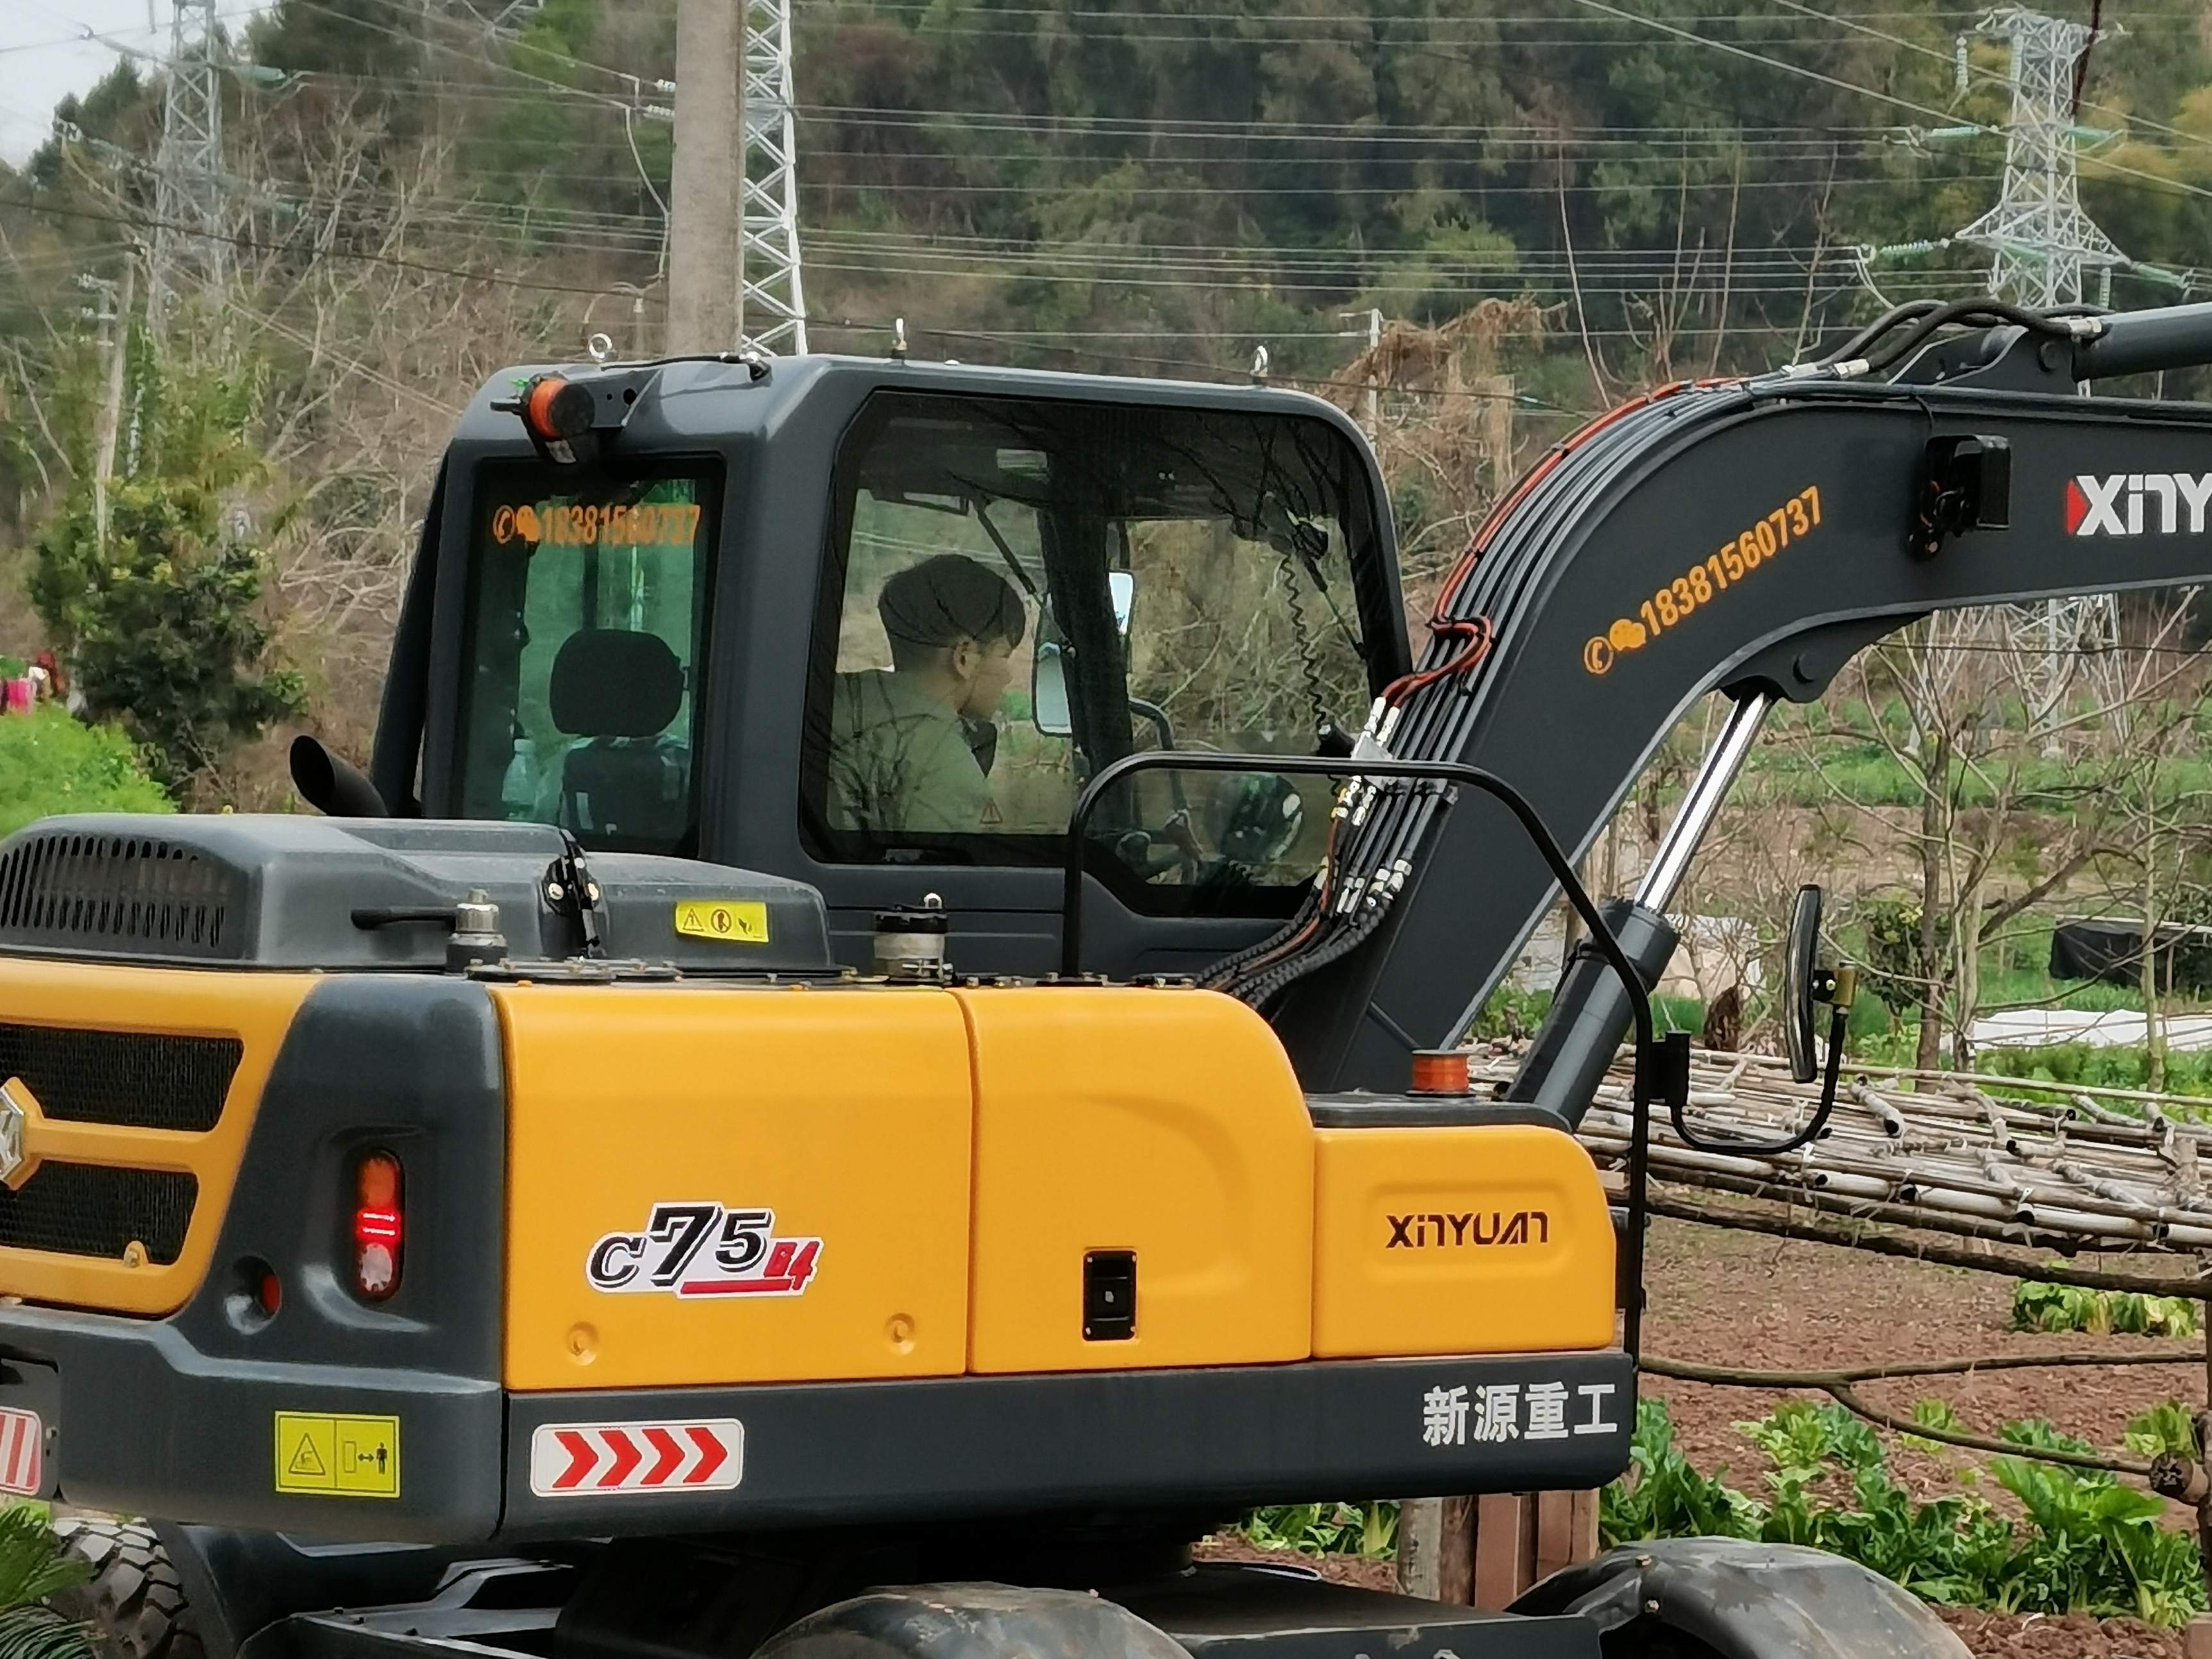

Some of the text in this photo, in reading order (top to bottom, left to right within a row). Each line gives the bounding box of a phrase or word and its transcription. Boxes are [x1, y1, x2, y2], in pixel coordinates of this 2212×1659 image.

[1640, 485, 1822, 636] 18381560737
[1423, 1381, 1618, 1446] 新源重工
